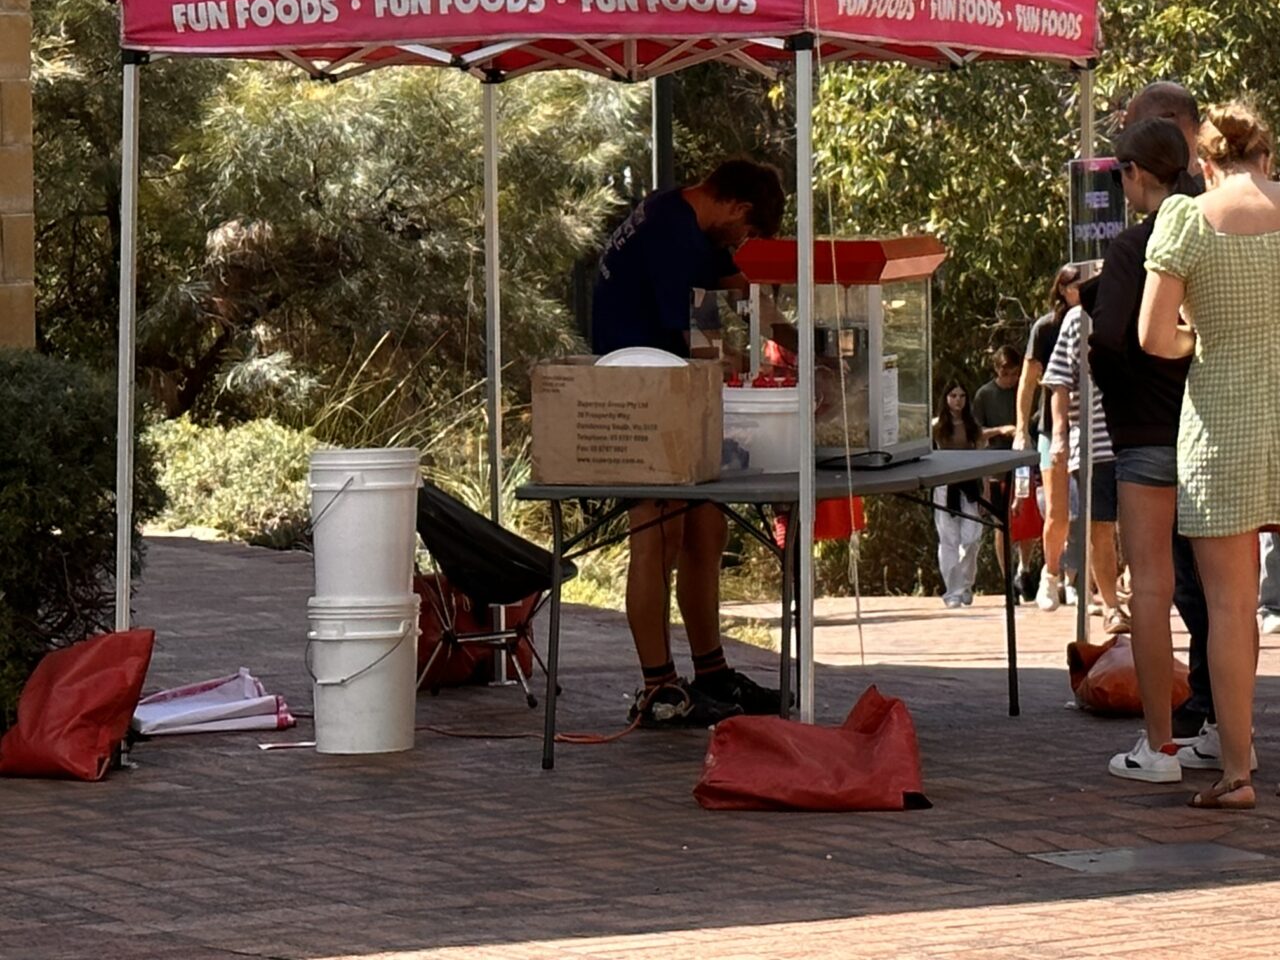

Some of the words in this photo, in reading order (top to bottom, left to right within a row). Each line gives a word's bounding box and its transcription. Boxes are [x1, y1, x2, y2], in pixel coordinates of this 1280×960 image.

[172, 1, 230, 33] FUN
[1015, 3, 1041, 34] FUN
[1040, 8, 1083, 41] FOODS
